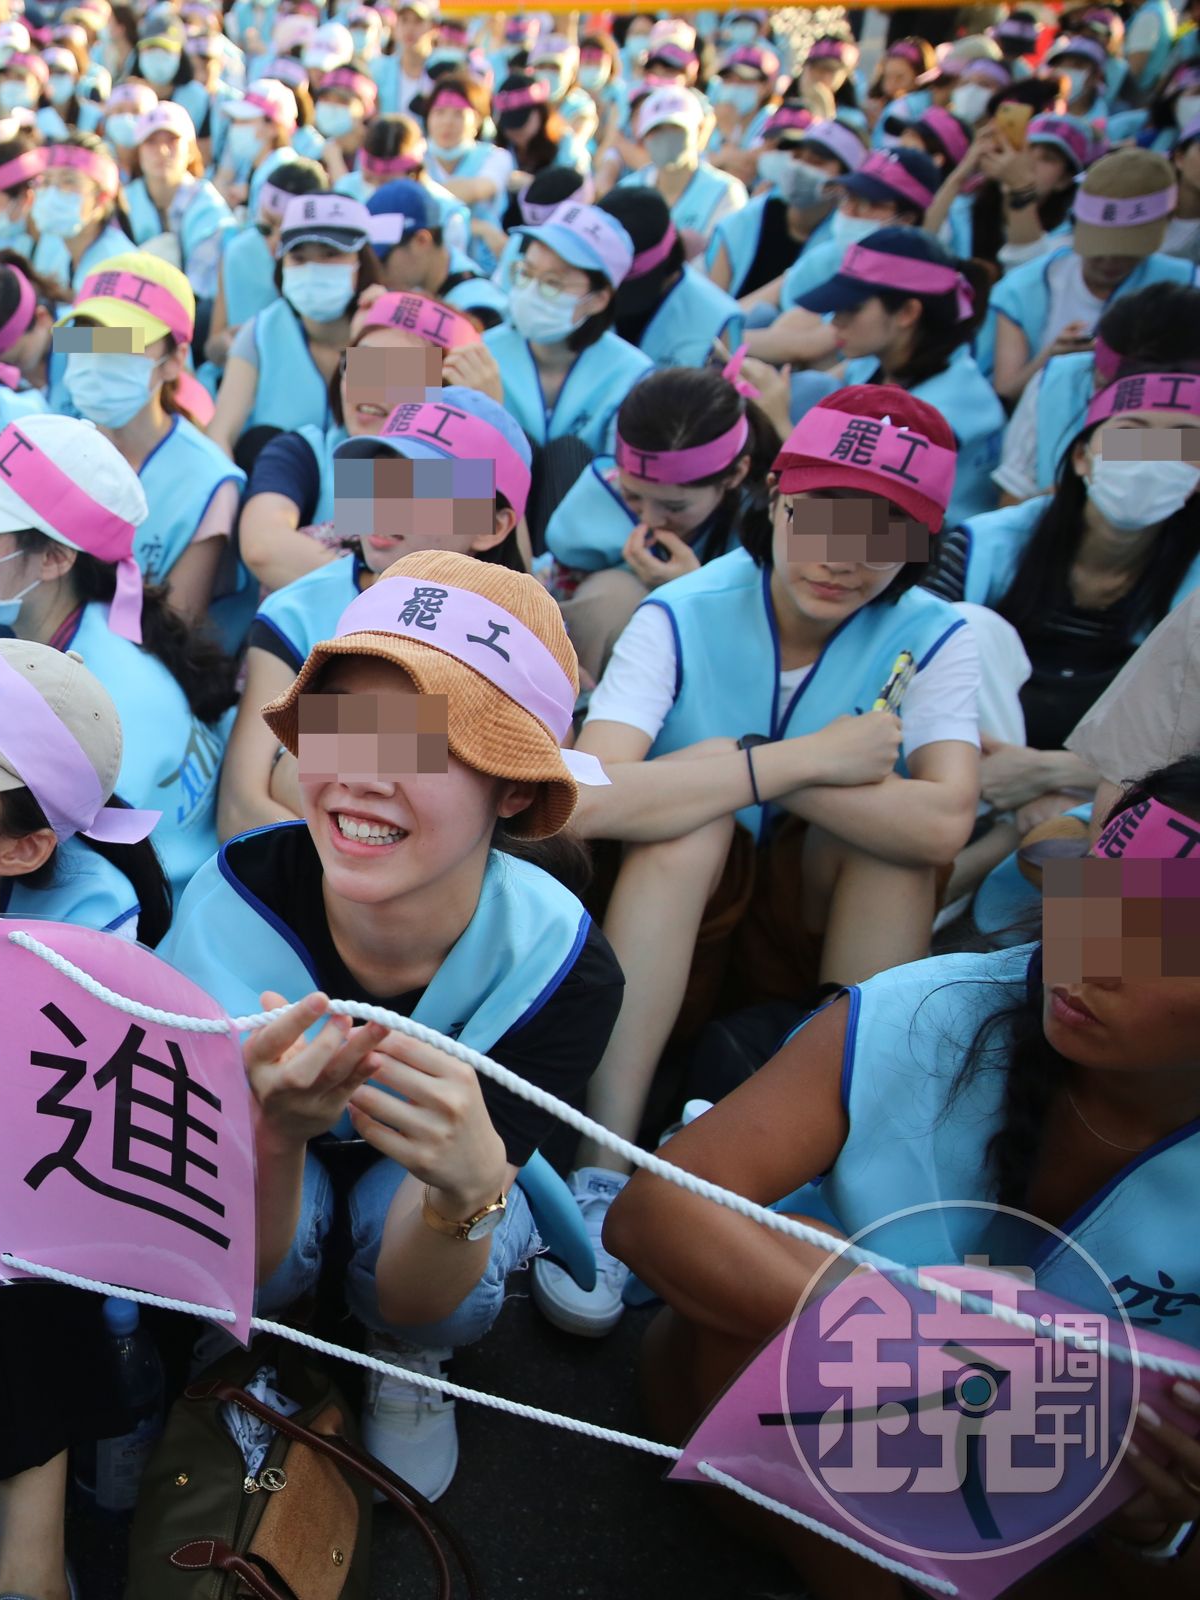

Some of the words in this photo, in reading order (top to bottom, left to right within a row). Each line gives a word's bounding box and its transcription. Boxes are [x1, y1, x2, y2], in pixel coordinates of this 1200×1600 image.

[92, 271, 157, 308] 罷工
[390, 296, 455, 343] 罷工
[1111, 377, 1196, 412] 罷工
[387, 403, 467, 446] 罷工
[830, 418, 929, 484] 罷工
[397, 587, 510, 663] 罷工
[24, 1002, 232, 1250] 進
